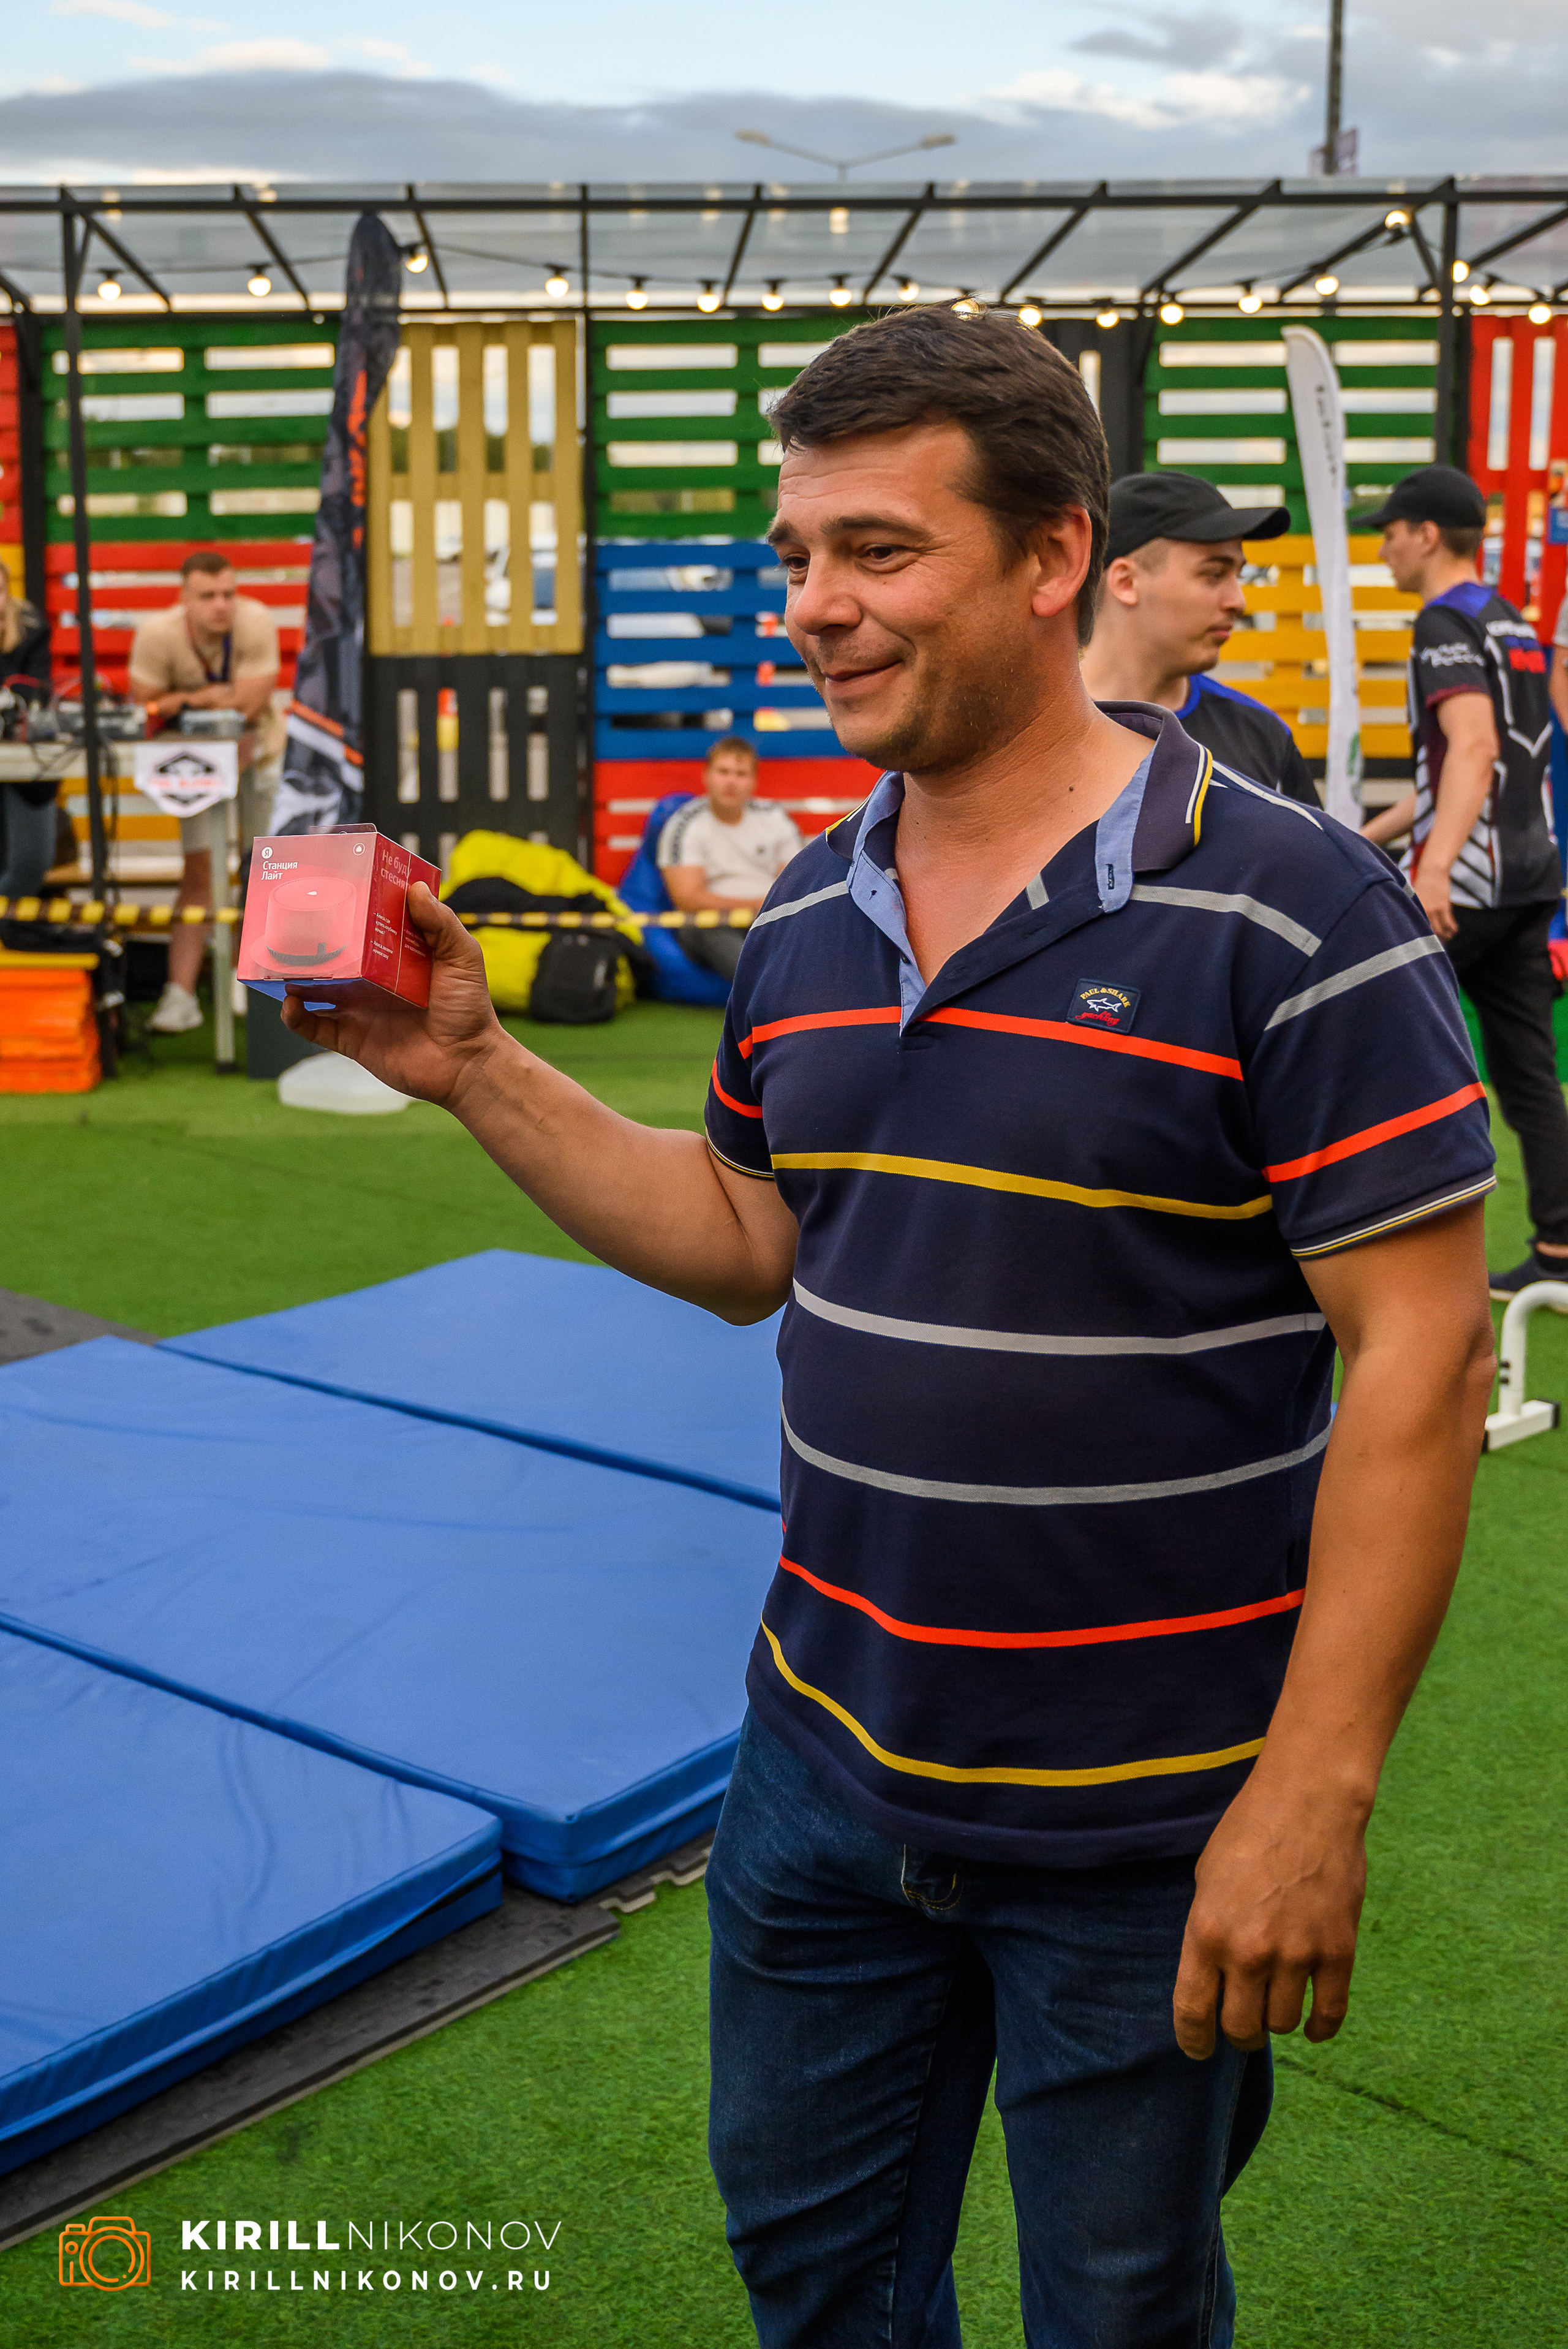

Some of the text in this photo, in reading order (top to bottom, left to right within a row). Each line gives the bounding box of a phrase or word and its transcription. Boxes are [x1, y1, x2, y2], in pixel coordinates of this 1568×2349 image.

[382, 849, 393, 865] Не
[262, 860, 298, 871] Станция
[261, 871, 284, 880] Лайт
